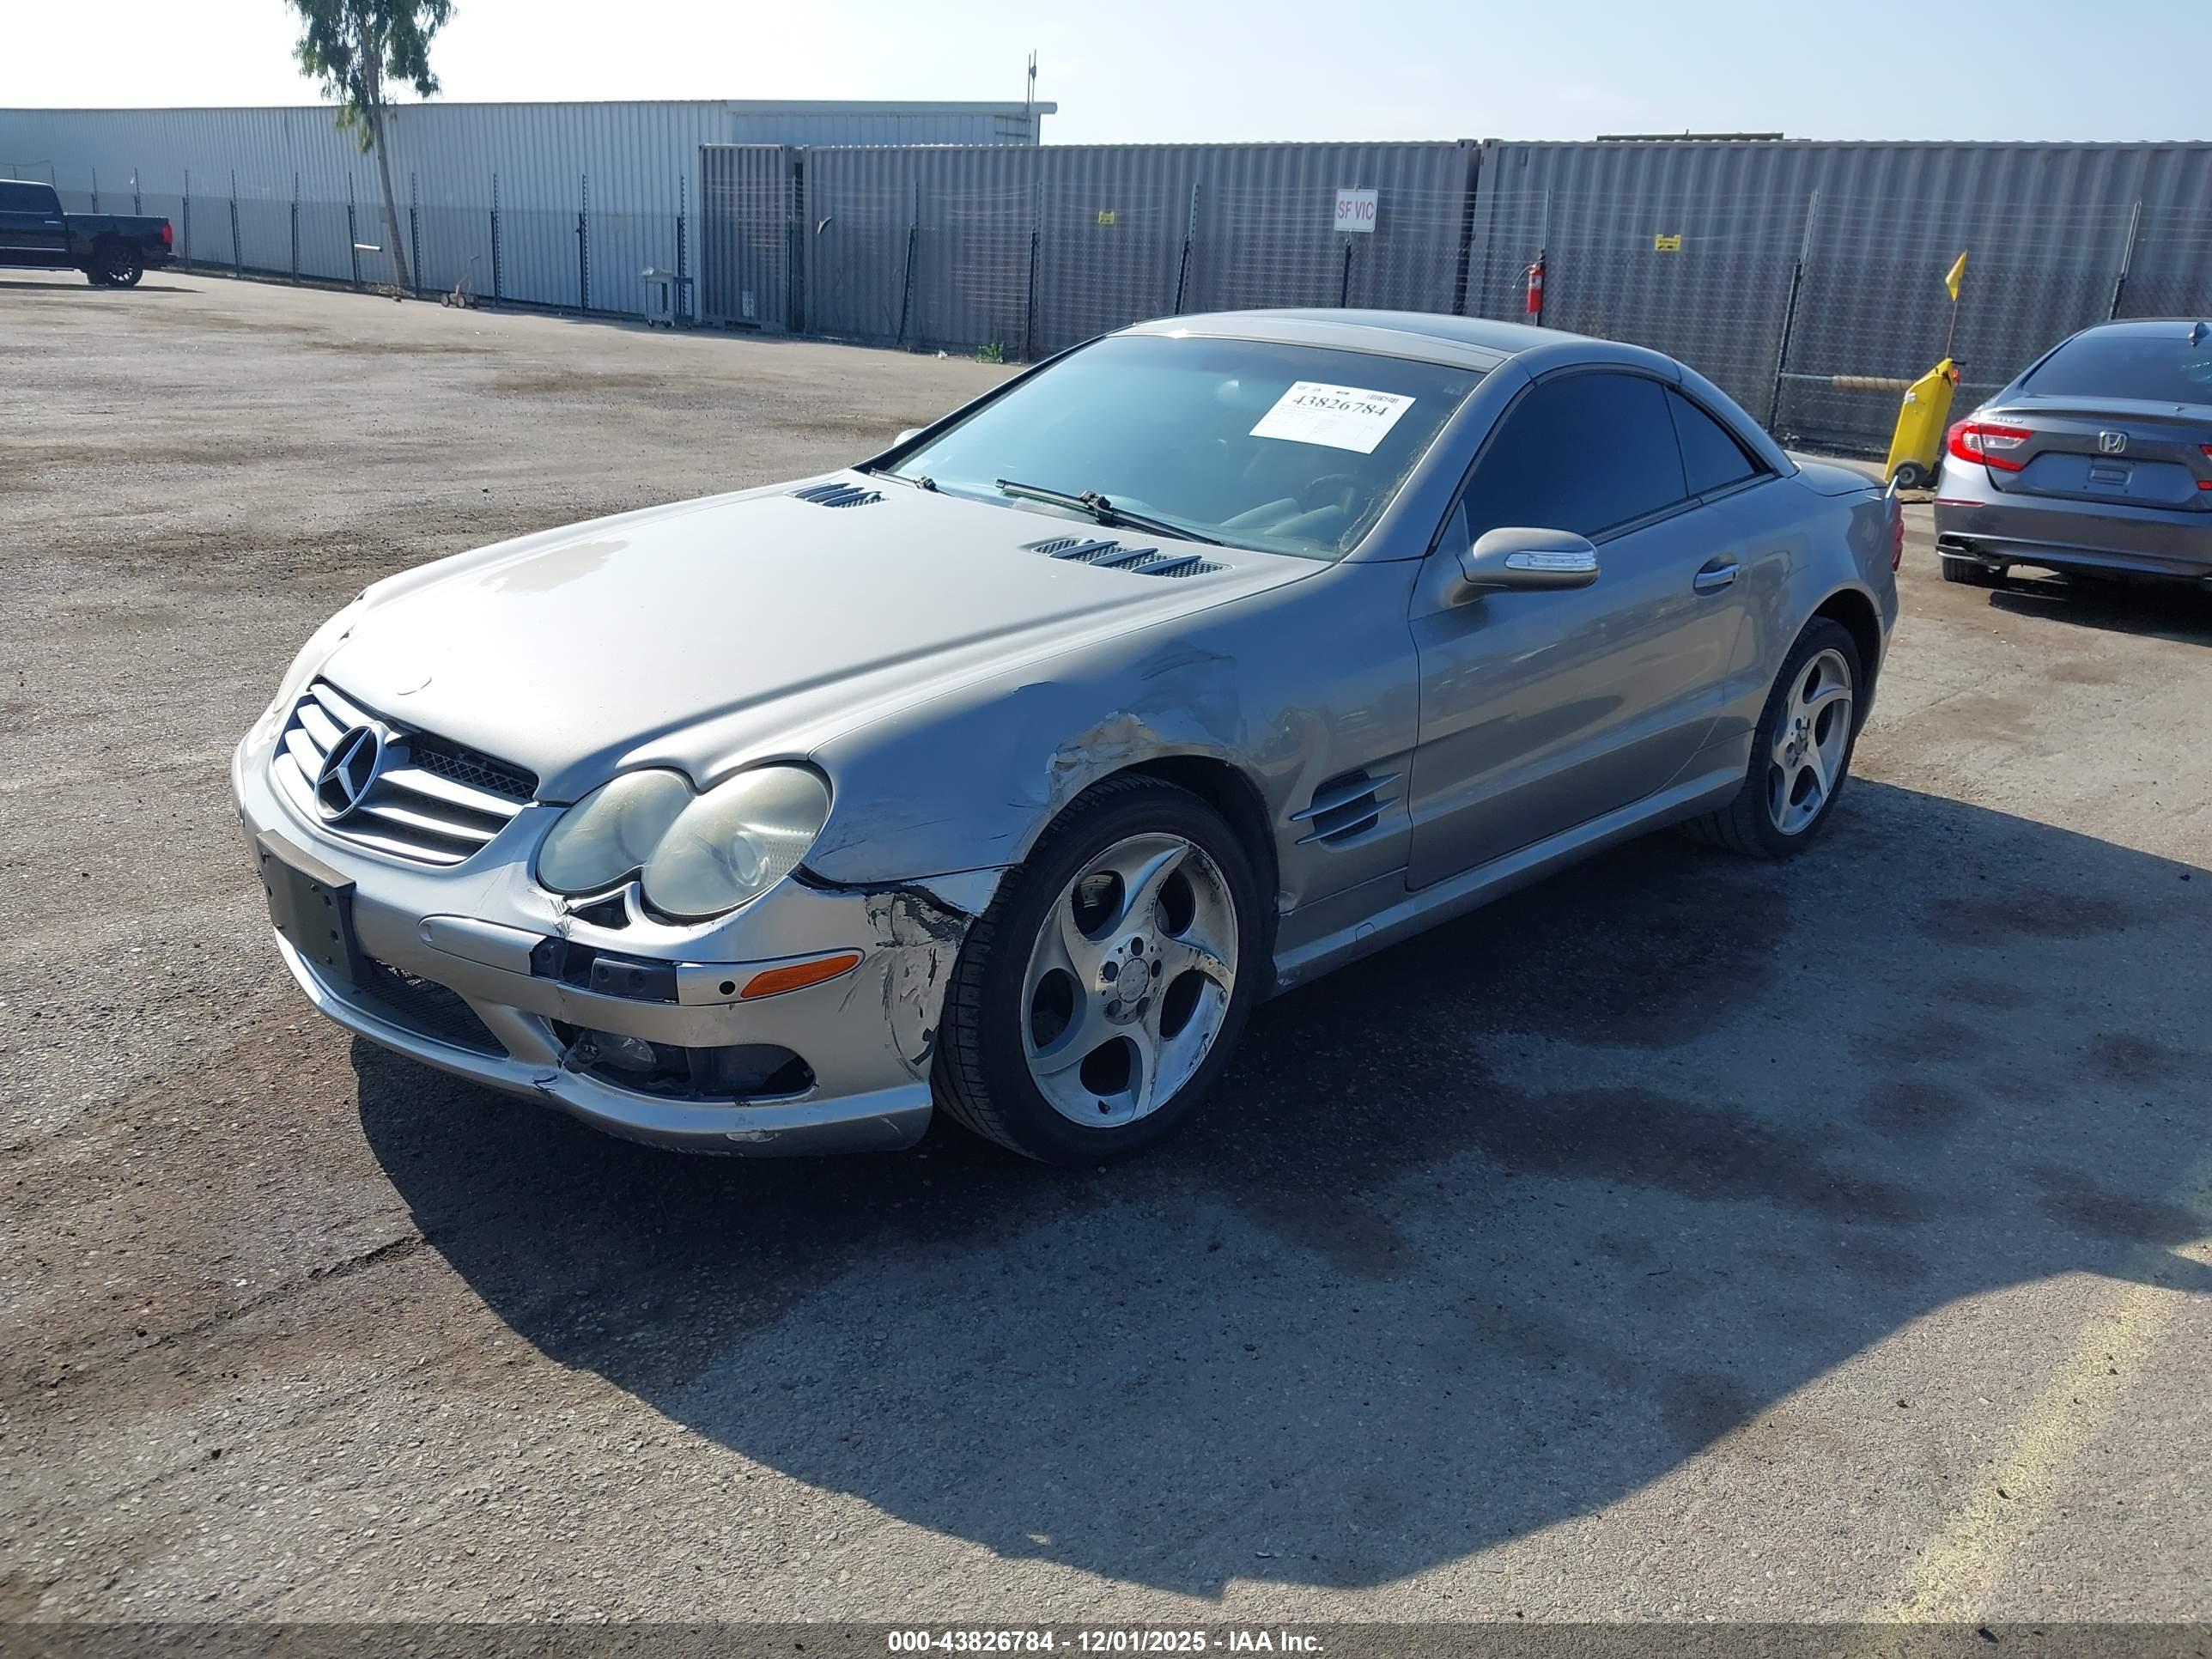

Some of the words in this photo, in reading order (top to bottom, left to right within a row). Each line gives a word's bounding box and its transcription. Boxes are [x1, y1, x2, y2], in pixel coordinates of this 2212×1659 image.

[1338, 200, 1352, 219] SF
[1355, 201, 1374, 220] VIC
[1292, 395, 1389, 416] 43826784
